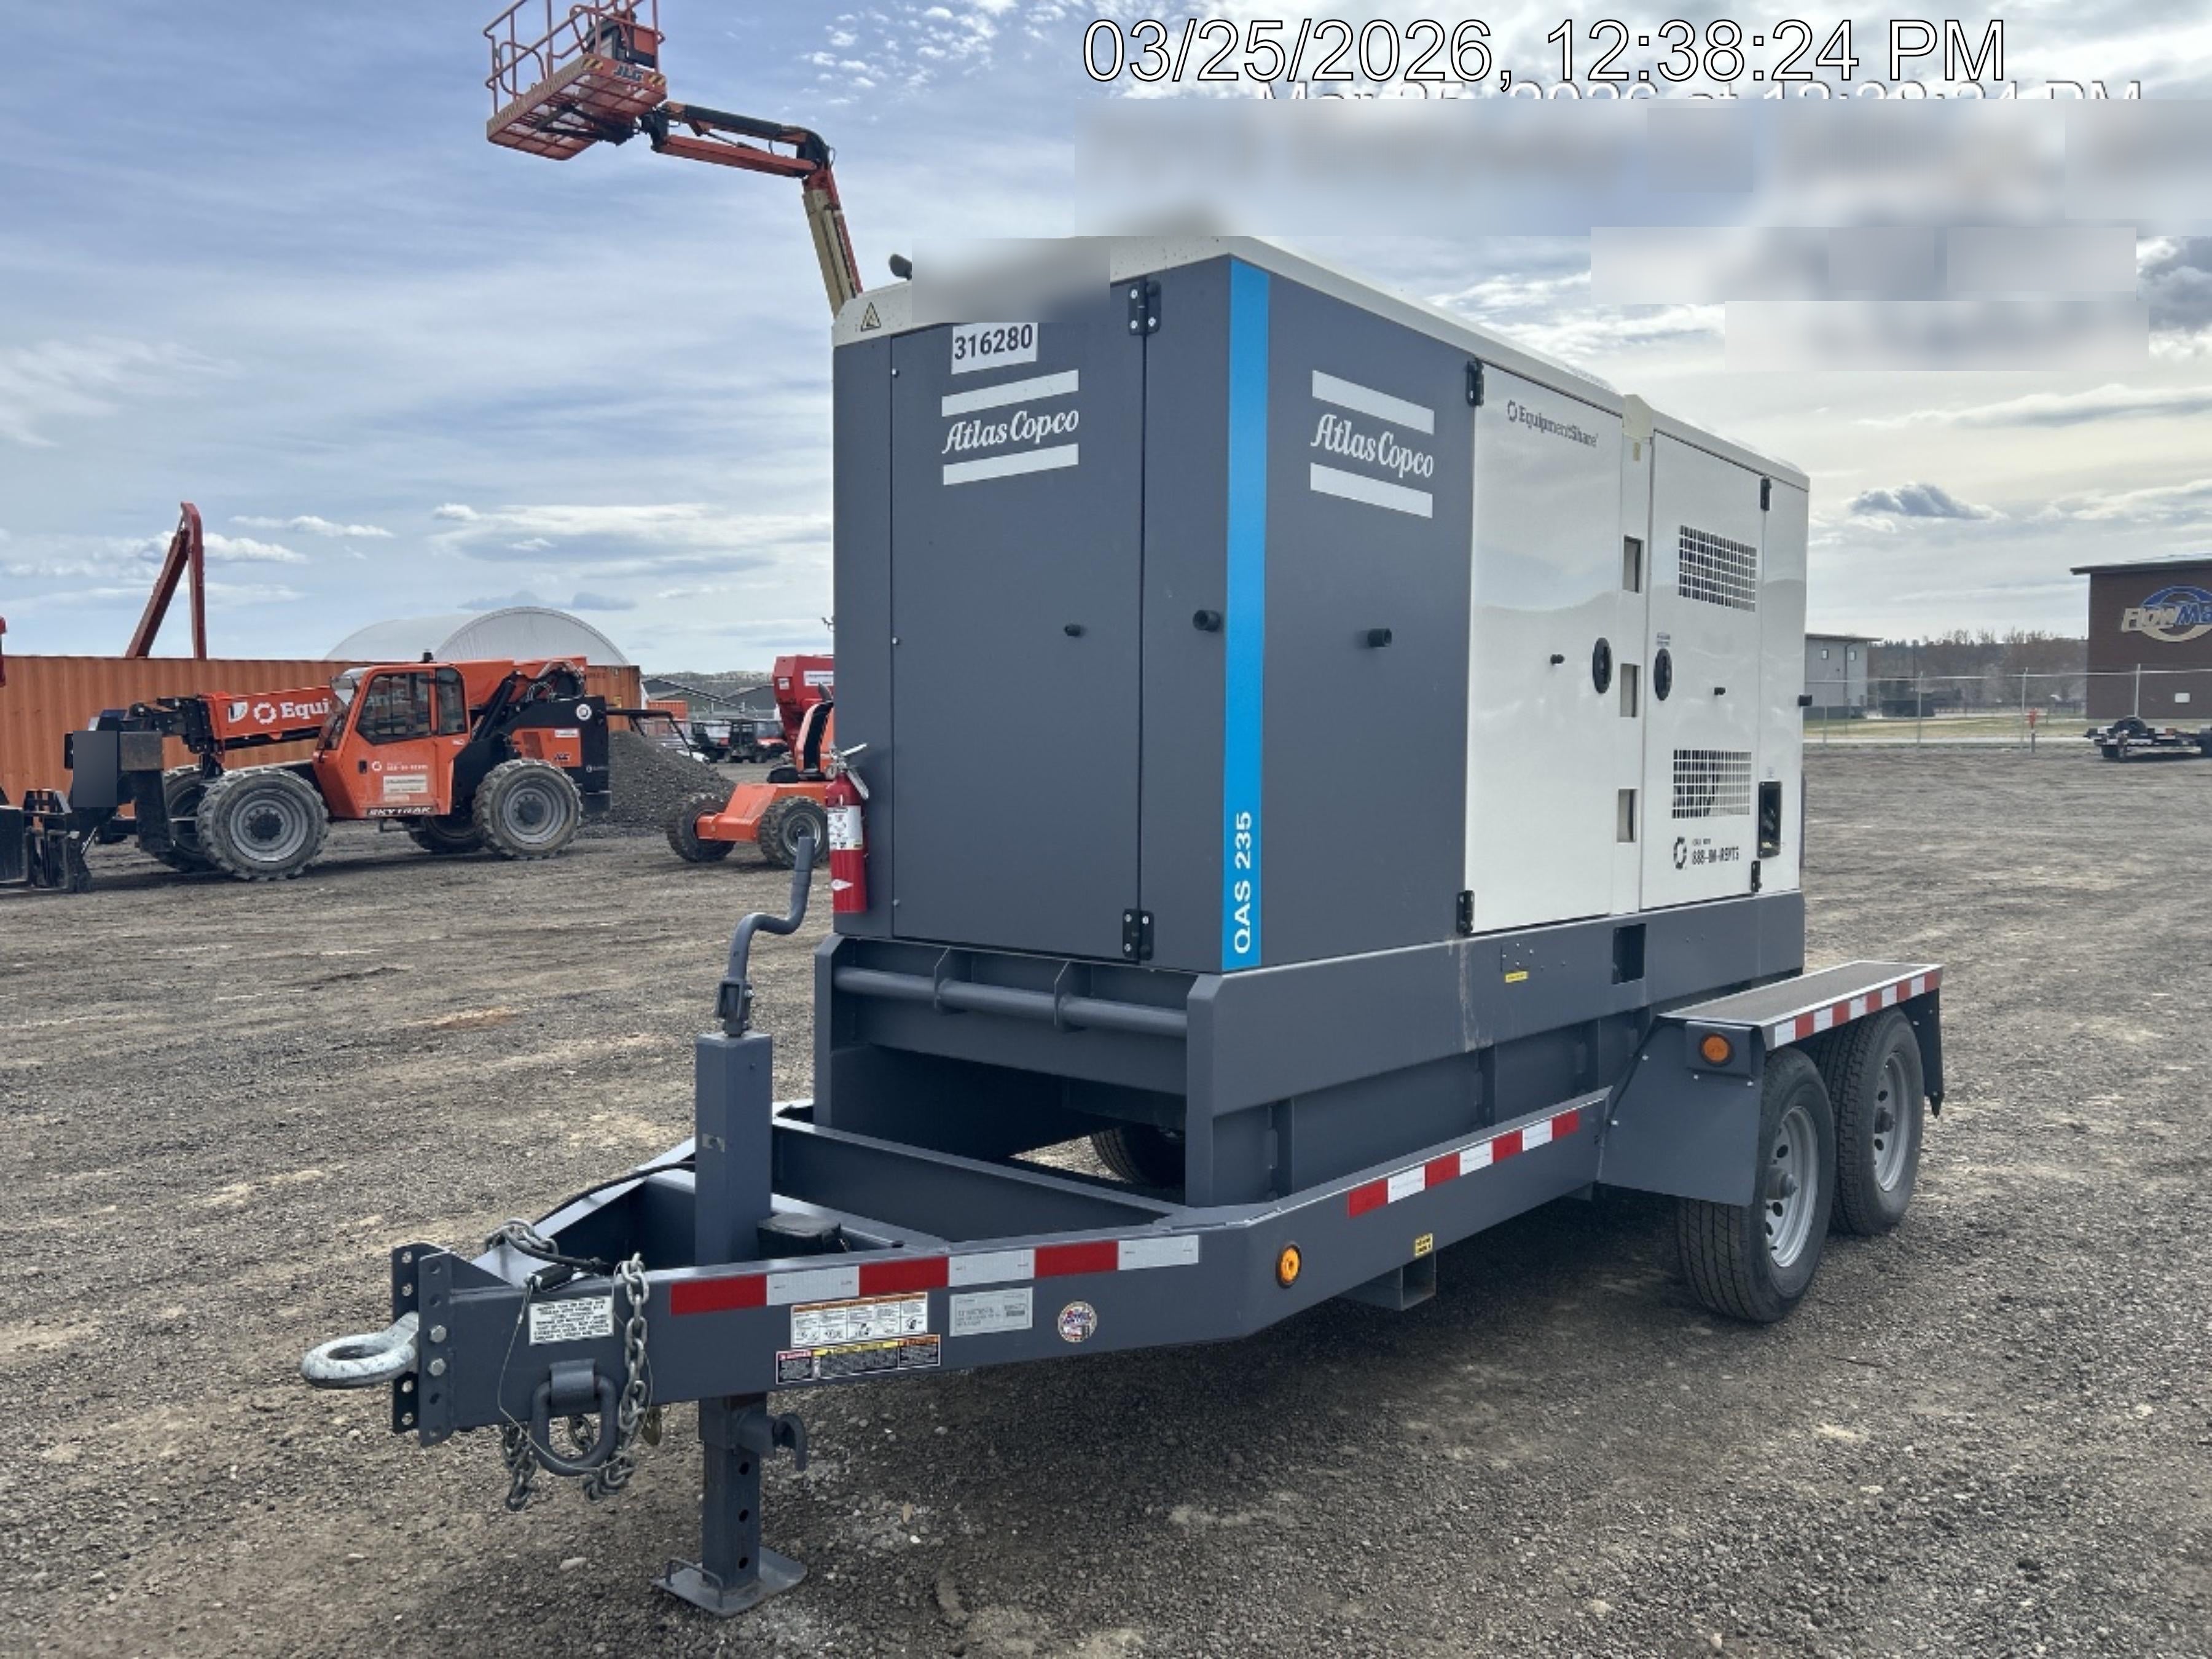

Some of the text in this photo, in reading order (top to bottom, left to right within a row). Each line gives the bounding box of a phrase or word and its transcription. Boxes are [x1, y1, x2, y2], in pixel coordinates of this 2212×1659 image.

[954, 324, 1033, 360] 316280
[941, 410, 1079, 455] Atlas Copco
[1310, 414, 1433, 478] Atlas Copco
[1234, 812, 1252, 954] QAS 235
